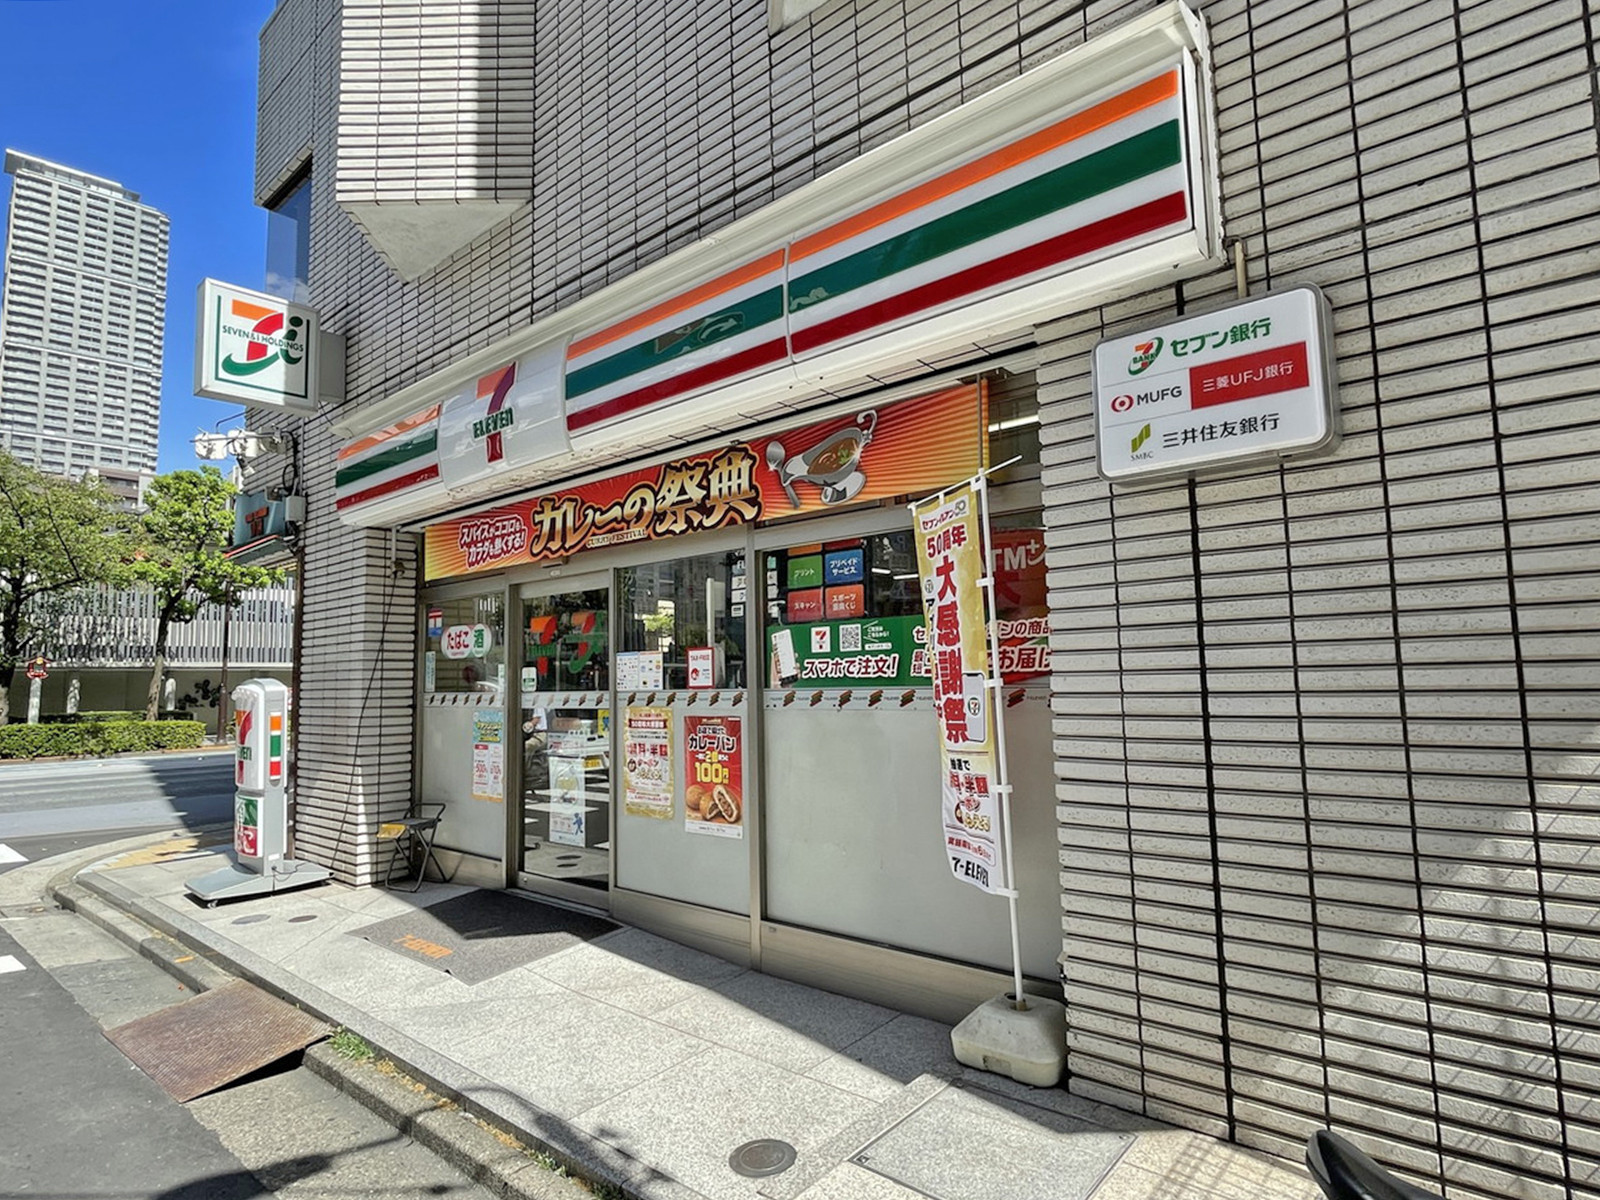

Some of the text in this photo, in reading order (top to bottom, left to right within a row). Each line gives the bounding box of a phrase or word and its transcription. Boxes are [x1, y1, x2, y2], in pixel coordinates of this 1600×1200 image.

[261, 335, 304, 352] HOLDINGS
[1169, 316, 1272, 358] セブン銀行
[1132, 353, 1157, 365] BANK
[1202, 360, 1295, 393] 三菱UFJ銀行
[1136, 385, 1183, 406] MUFG
[472, 406, 515, 439] ELEVEN
[1162, 412, 1281, 449] 三井住友銀行
[1130, 450, 1154, 462] SMBC
[530, 450, 759, 554] カレーの祭典
[611, 528, 648, 542] FESTIVAL
[926, 523, 967, 558] 50周年
[794, 567, 815, 578] プリント
[829, 556, 858, 569] プリペイド
[832, 566, 857, 576] サービス
[794, 600, 816, 610] スキャン
[446, 629, 470, 651] たばこ
[935, 554, 969, 744] 大感謝祭
[803, 655, 898, 677] スマホで注文!
[689, 735, 735, 752] カレーパン
[951, 856, 990, 888] 7-ELEVEN
